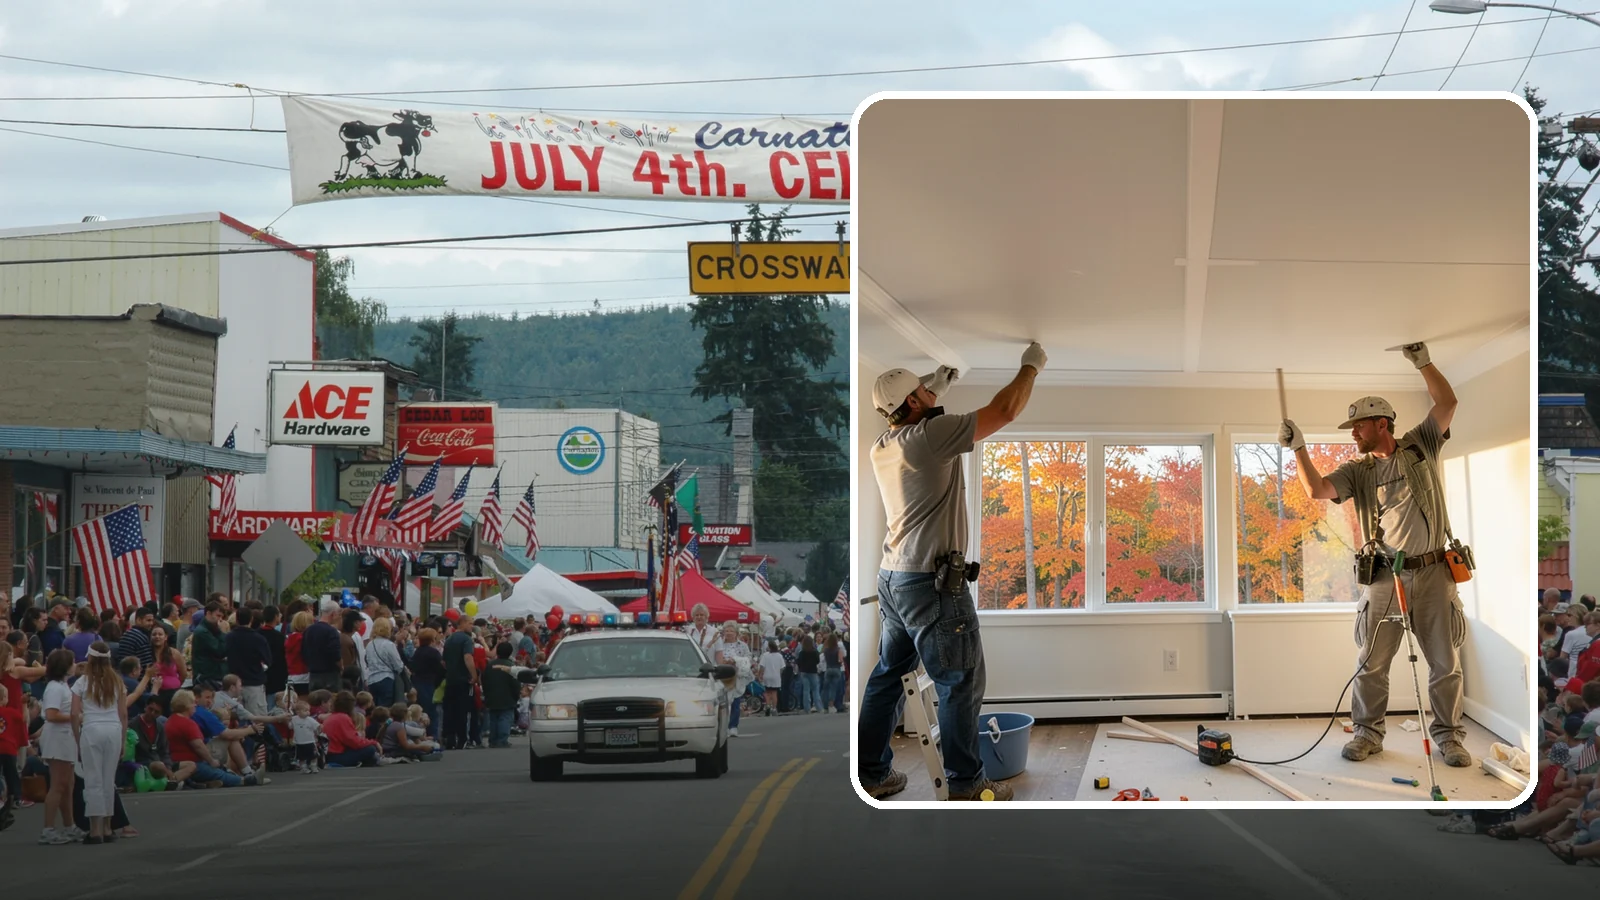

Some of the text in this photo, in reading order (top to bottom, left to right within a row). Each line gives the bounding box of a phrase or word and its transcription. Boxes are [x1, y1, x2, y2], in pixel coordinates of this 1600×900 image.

[481, 141, 605, 192] JULY
[632, 150, 747, 198] 4th.
[697, 254, 850, 280] CROSSWA
[283, 380, 374, 420] ACE
[406, 409, 453, 422] CEDAR
[283, 421, 371, 437] Hardware
[416, 428, 477, 446] Coca-Cola
[353, 467, 384, 481] Simpl
[83, 485, 155, 495] St. Vincent de Paul
[81, 503, 153, 522] THT
[688, 526, 741, 535] CRNATION
[699, 535, 730, 543] GLASS
